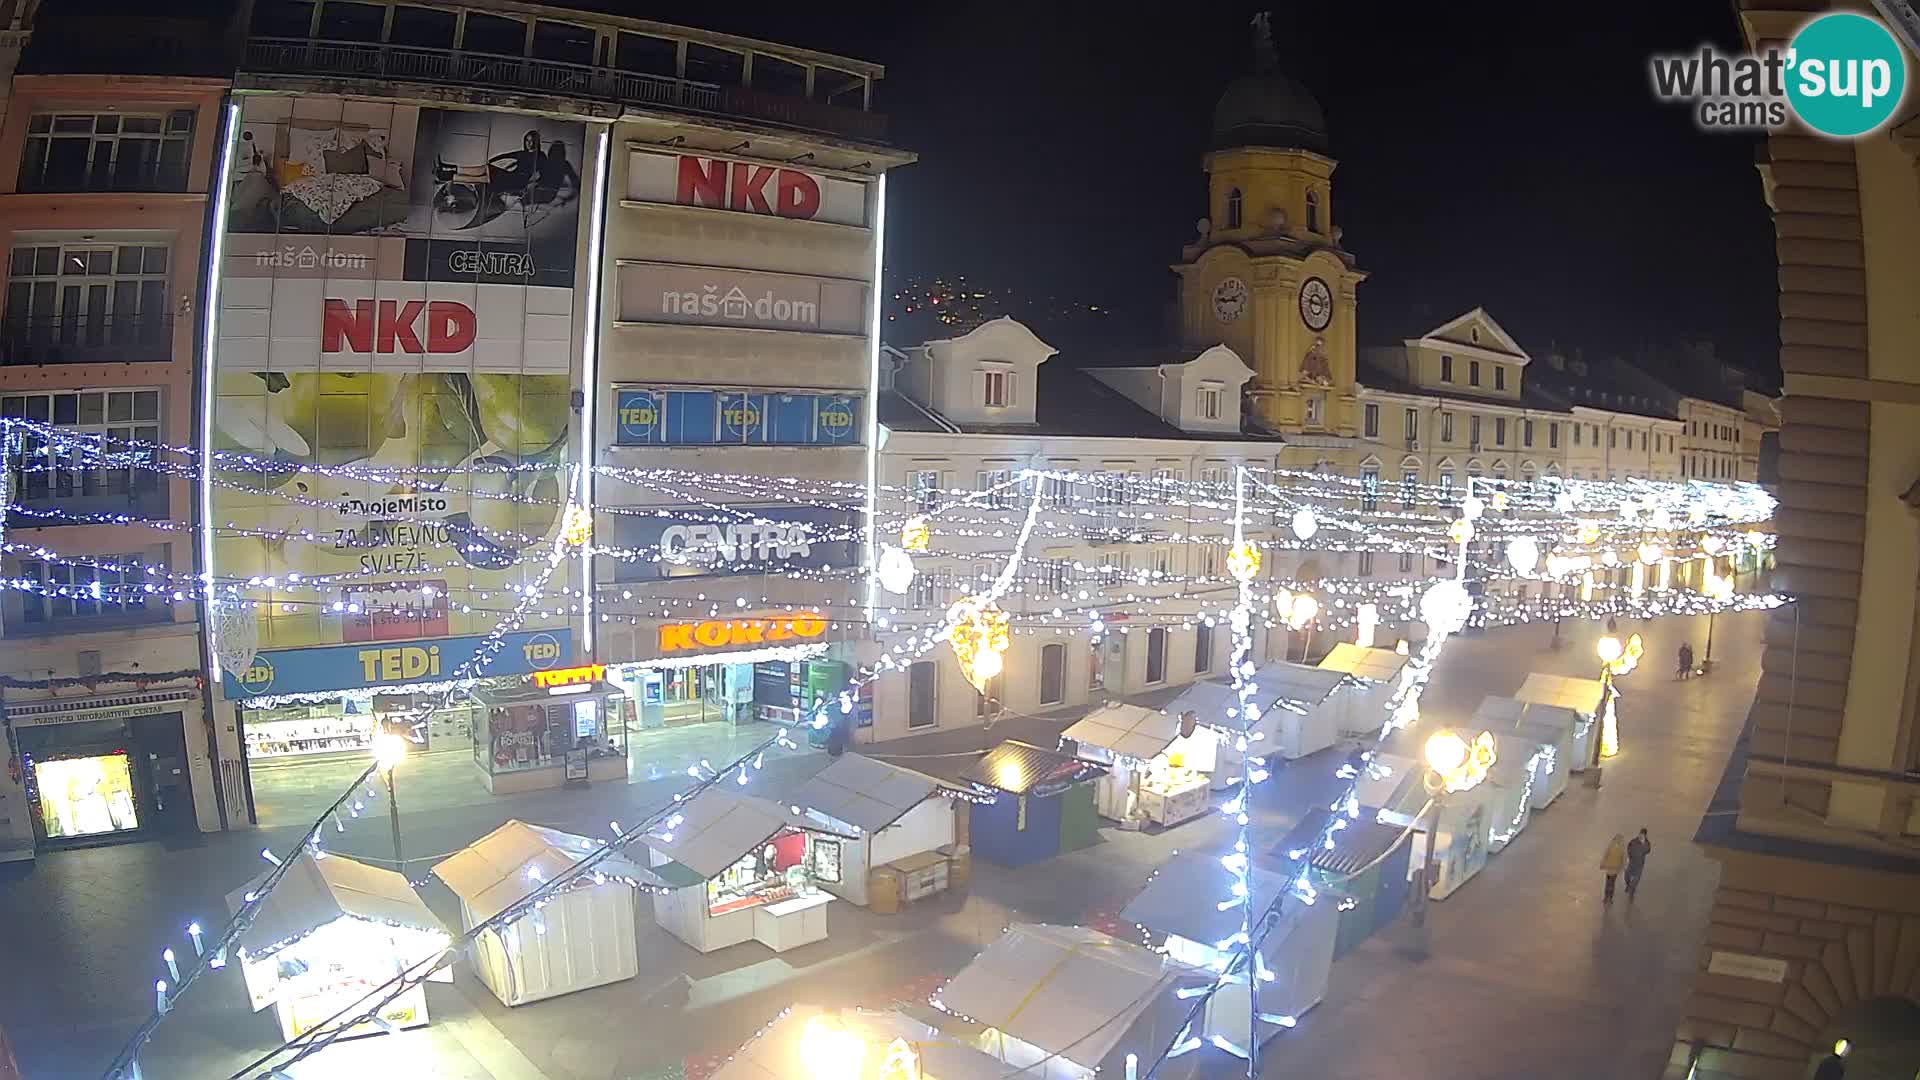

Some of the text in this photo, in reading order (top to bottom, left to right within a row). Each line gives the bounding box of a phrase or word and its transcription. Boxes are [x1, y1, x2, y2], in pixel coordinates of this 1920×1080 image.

[677, 155, 821, 220] NKD
[255, 246, 367, 269] naš dom
[448, 250, 536, 277] CENTRA
[662, 285, 817, 323] naš dom
[322, 298, 478, 353] NKD
[619, 408, 658, 426] TEDi
[723, 409, 760, 426] TEDi
[820, 411, 853, 427] TEDi
[338, 496, 447, 516] #TvojeMisto
[334, 524, 451, 549] ZA DNEVNO
[659, 521, 811, 563] CENTRA
[360, 547, 428, 574] SVJEŽE
[659, 612, 828, 651] KORZO
[359, 646, 441, 682] TEDi
[523, 642, 561, 660] TEDi
[534, 664, 607, 688] TOMMY
